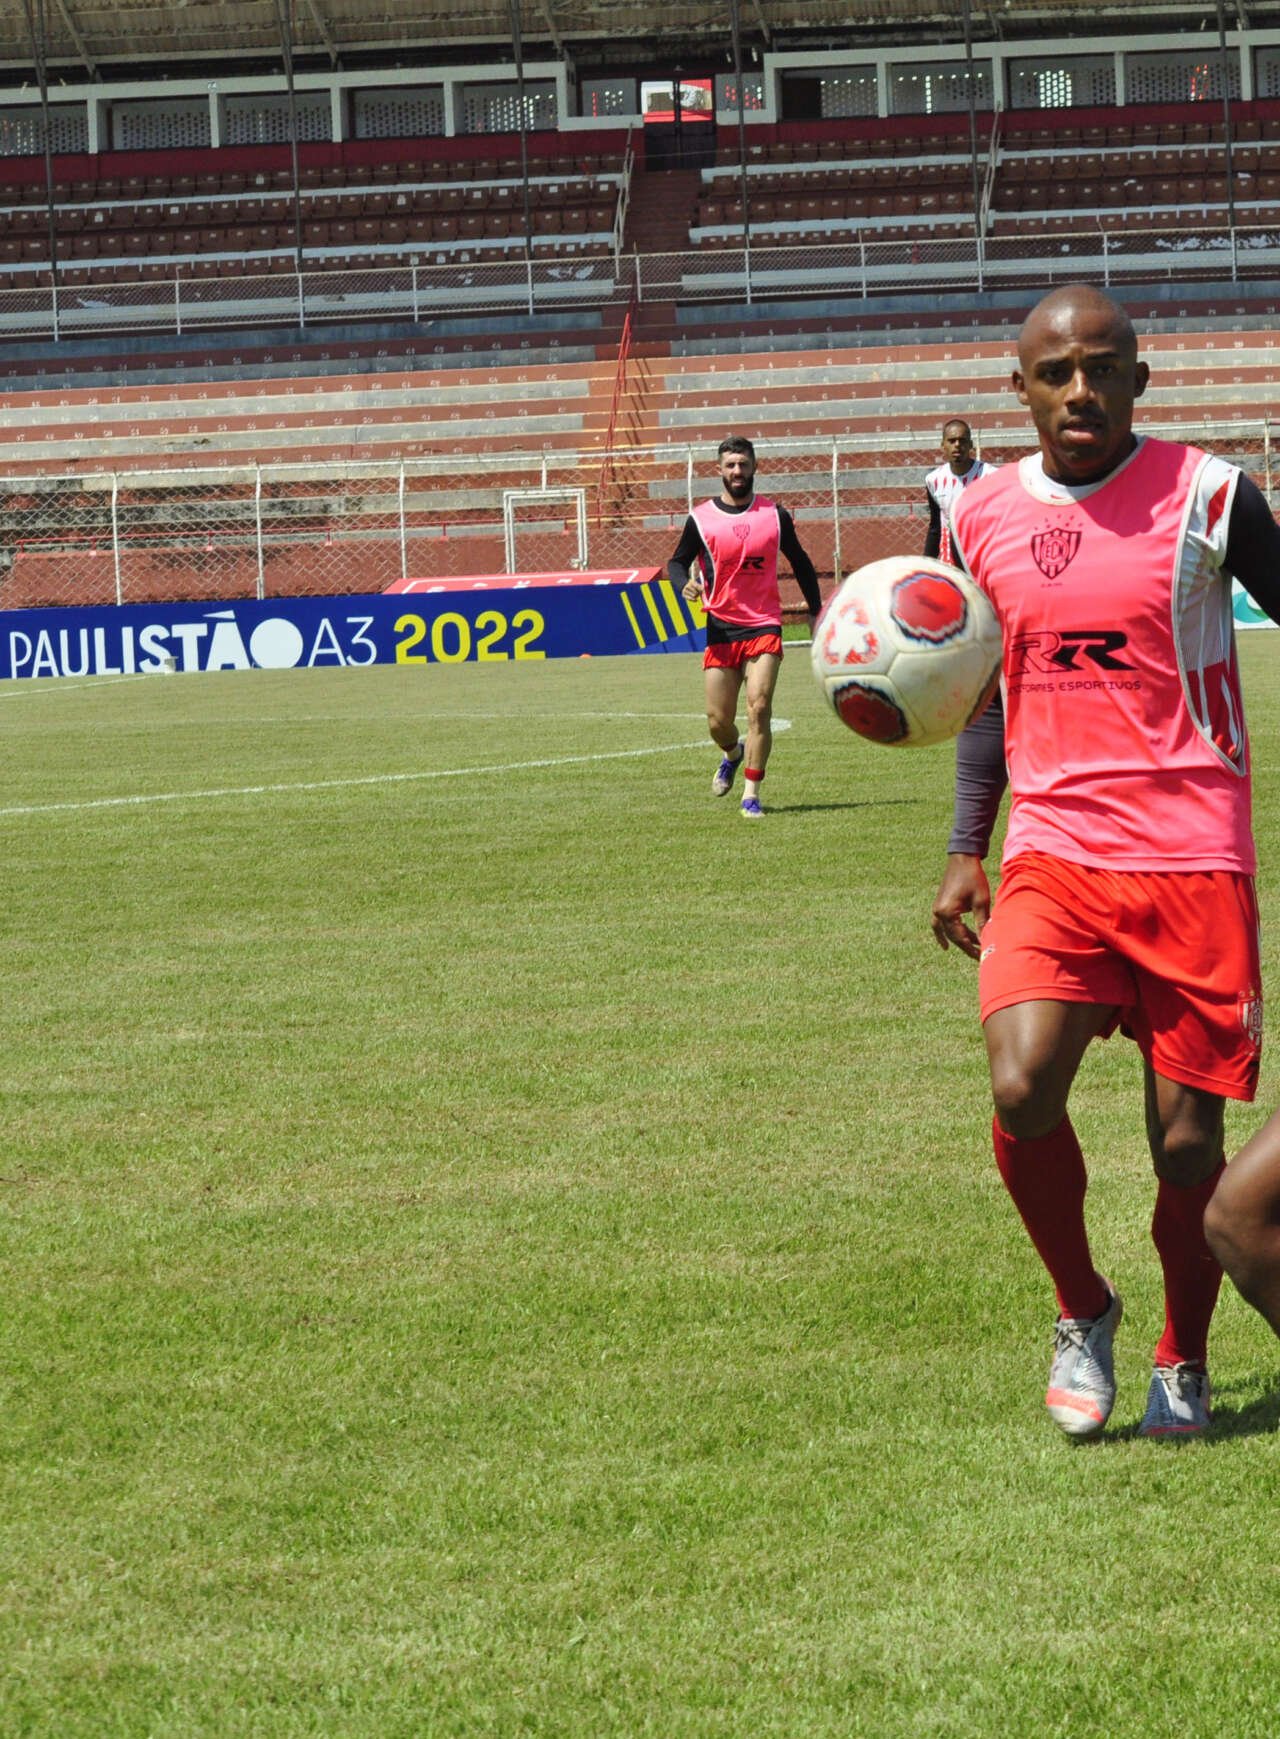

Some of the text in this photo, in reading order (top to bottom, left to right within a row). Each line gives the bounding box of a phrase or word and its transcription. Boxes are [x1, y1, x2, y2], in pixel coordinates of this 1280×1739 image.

[9, 607, 547, 679] PAULISTÃO A3 2022
[1008, 630, 1139, 678] RR
[1058, 680, 1142, 692] ESPORTIVOS
